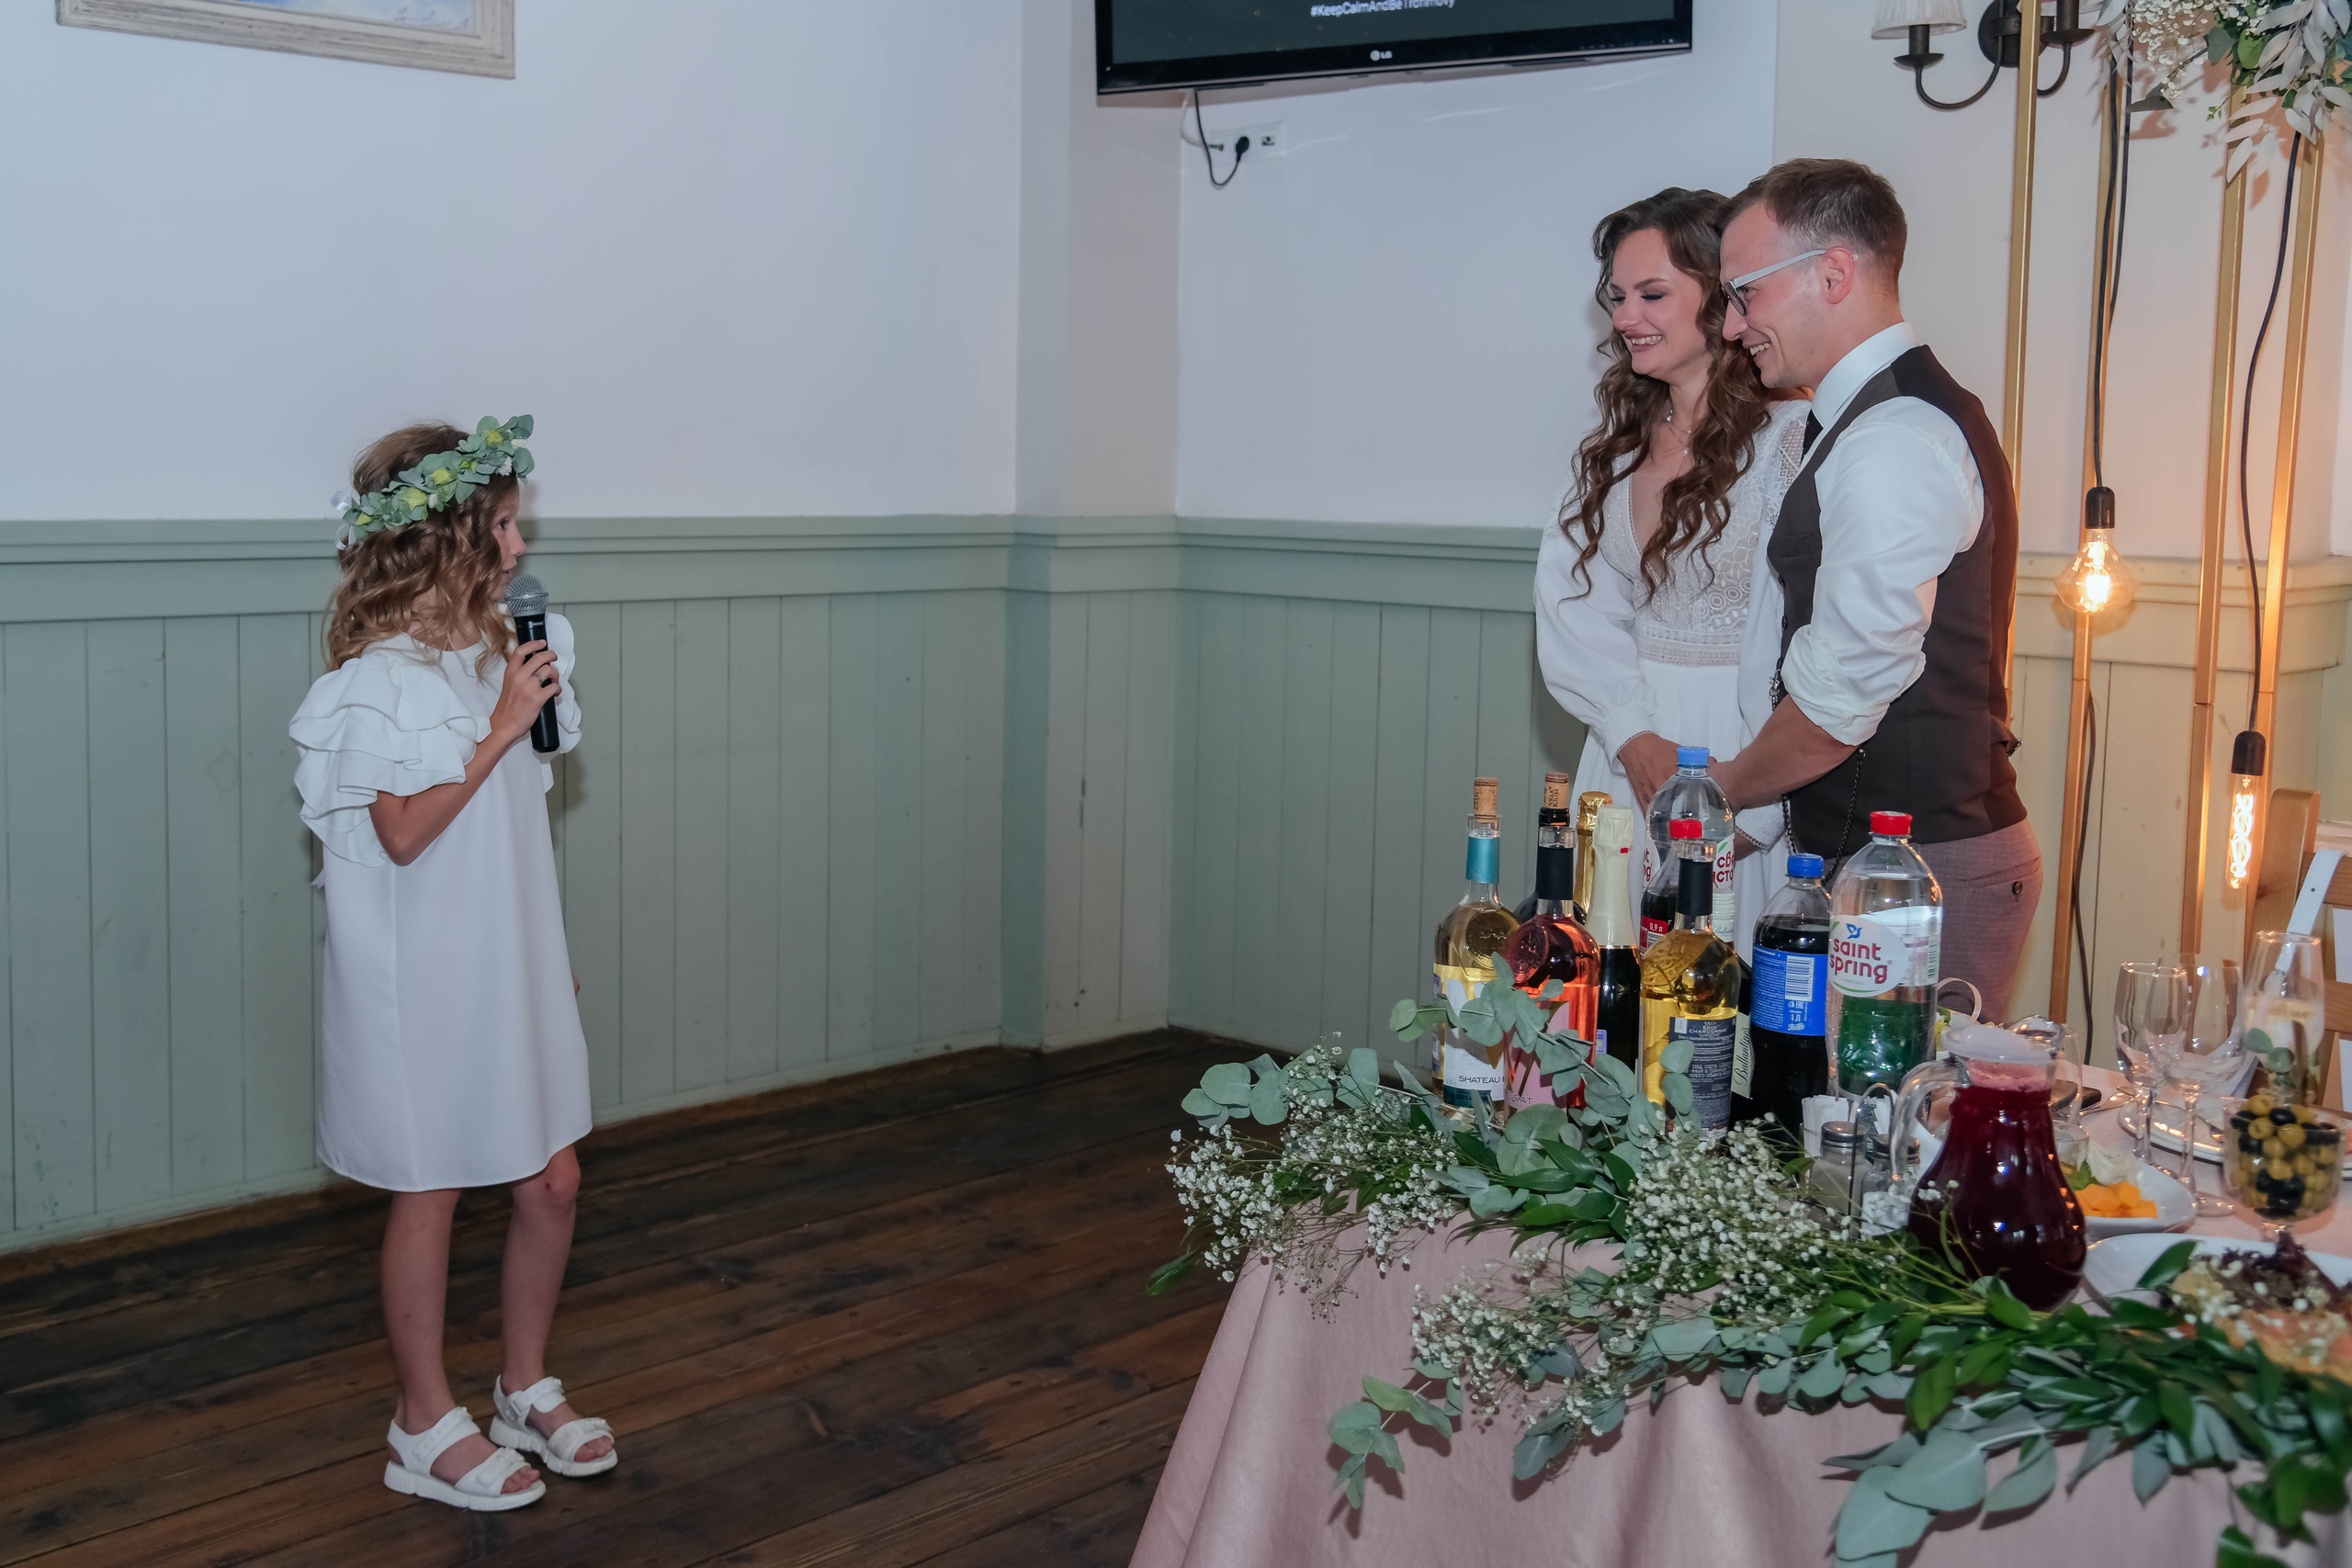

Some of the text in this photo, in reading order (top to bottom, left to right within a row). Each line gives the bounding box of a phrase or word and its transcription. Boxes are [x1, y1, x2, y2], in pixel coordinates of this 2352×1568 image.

[1649, 922, 1657, 932] 0,9
[1833, 938, 1882, 962] saint
[1829, 953, 1888, 985] spring
[1458, 1075, 1501, 1084] SHATEAU
